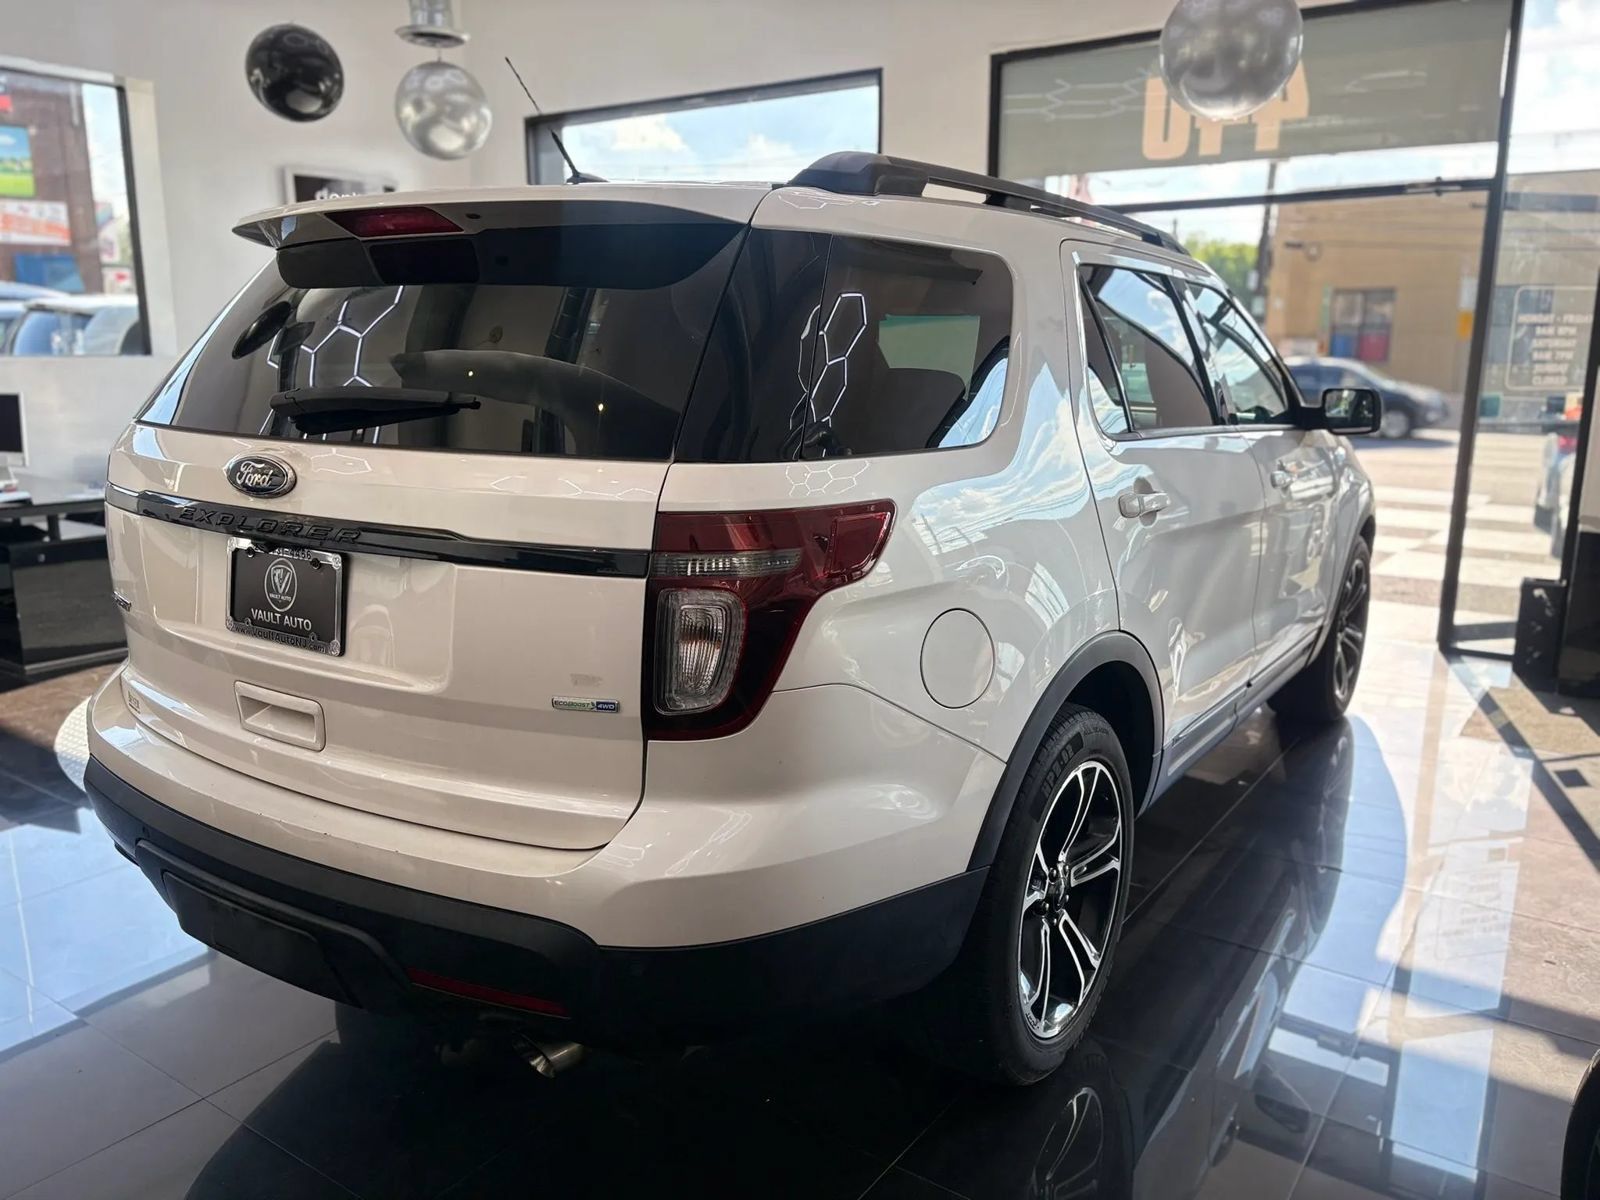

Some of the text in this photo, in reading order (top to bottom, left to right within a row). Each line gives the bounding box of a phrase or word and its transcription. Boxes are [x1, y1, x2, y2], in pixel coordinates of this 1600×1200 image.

[236, 460, 273, 488] Ford
[178, 506, 364, 545] EXPLORER
[251, 607, 312, 631] VAULT AUTO
